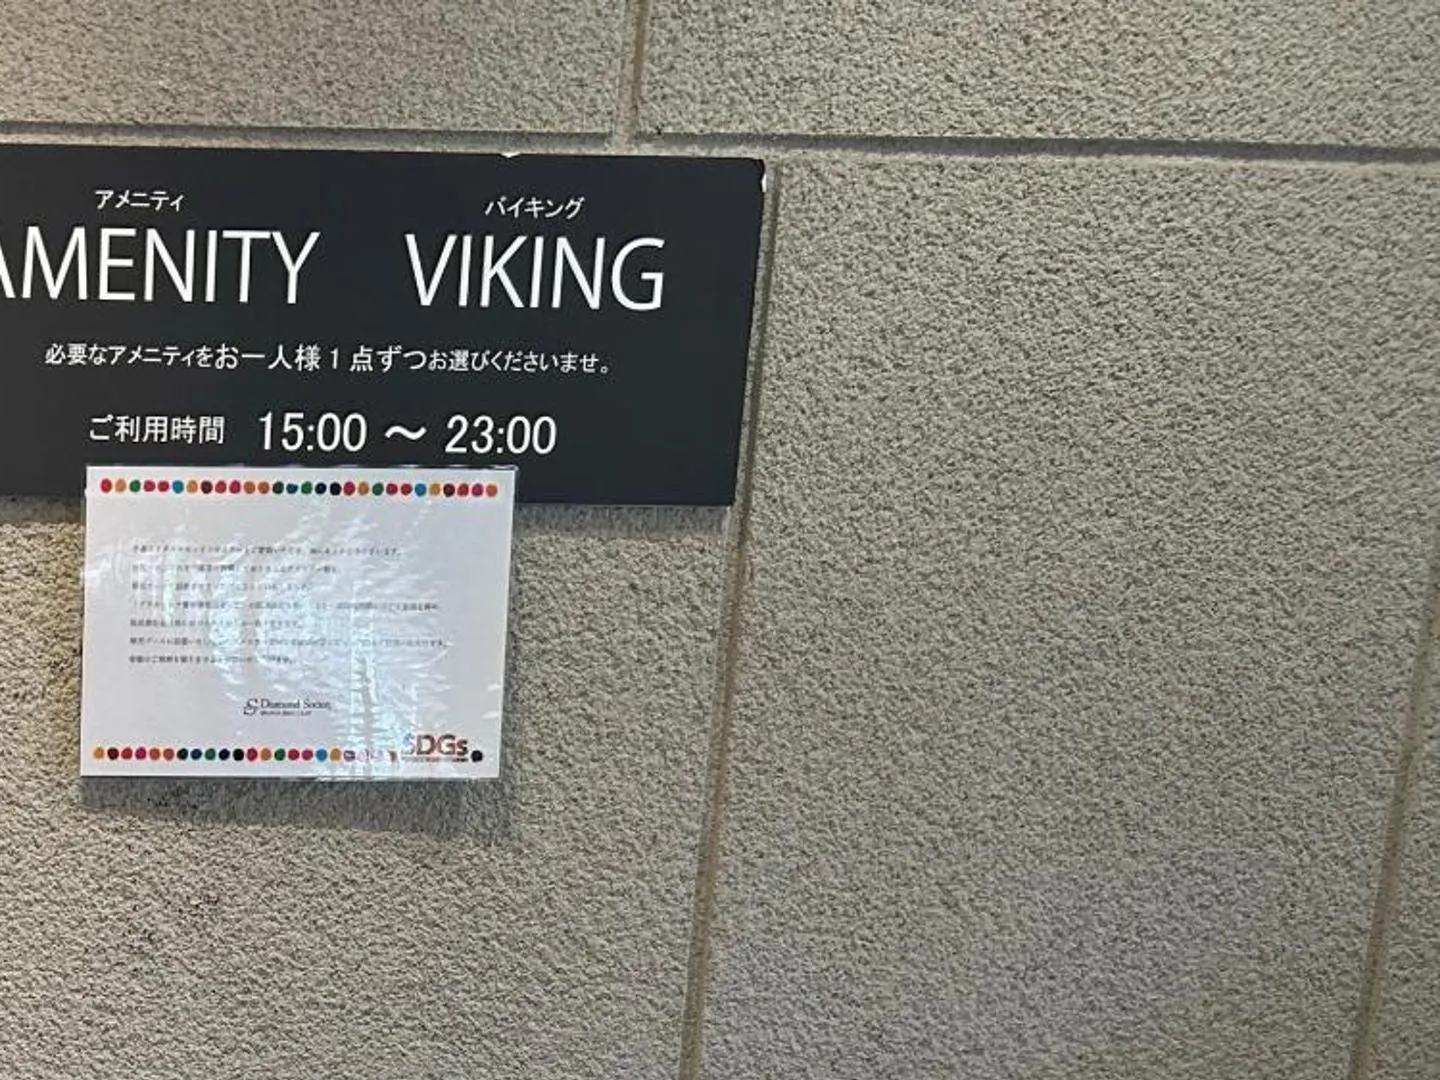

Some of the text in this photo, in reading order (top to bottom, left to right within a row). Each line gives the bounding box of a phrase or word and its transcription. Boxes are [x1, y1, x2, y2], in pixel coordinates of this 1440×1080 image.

[95, 189, 585, 220] アメニティ バイキング
[404, 233, 666, 311] VIKING
[89, 413, 226, 444] ご利用時間
[258, 410, 368, 452] 15:00
[444, 414, 558, 454] 23:00
